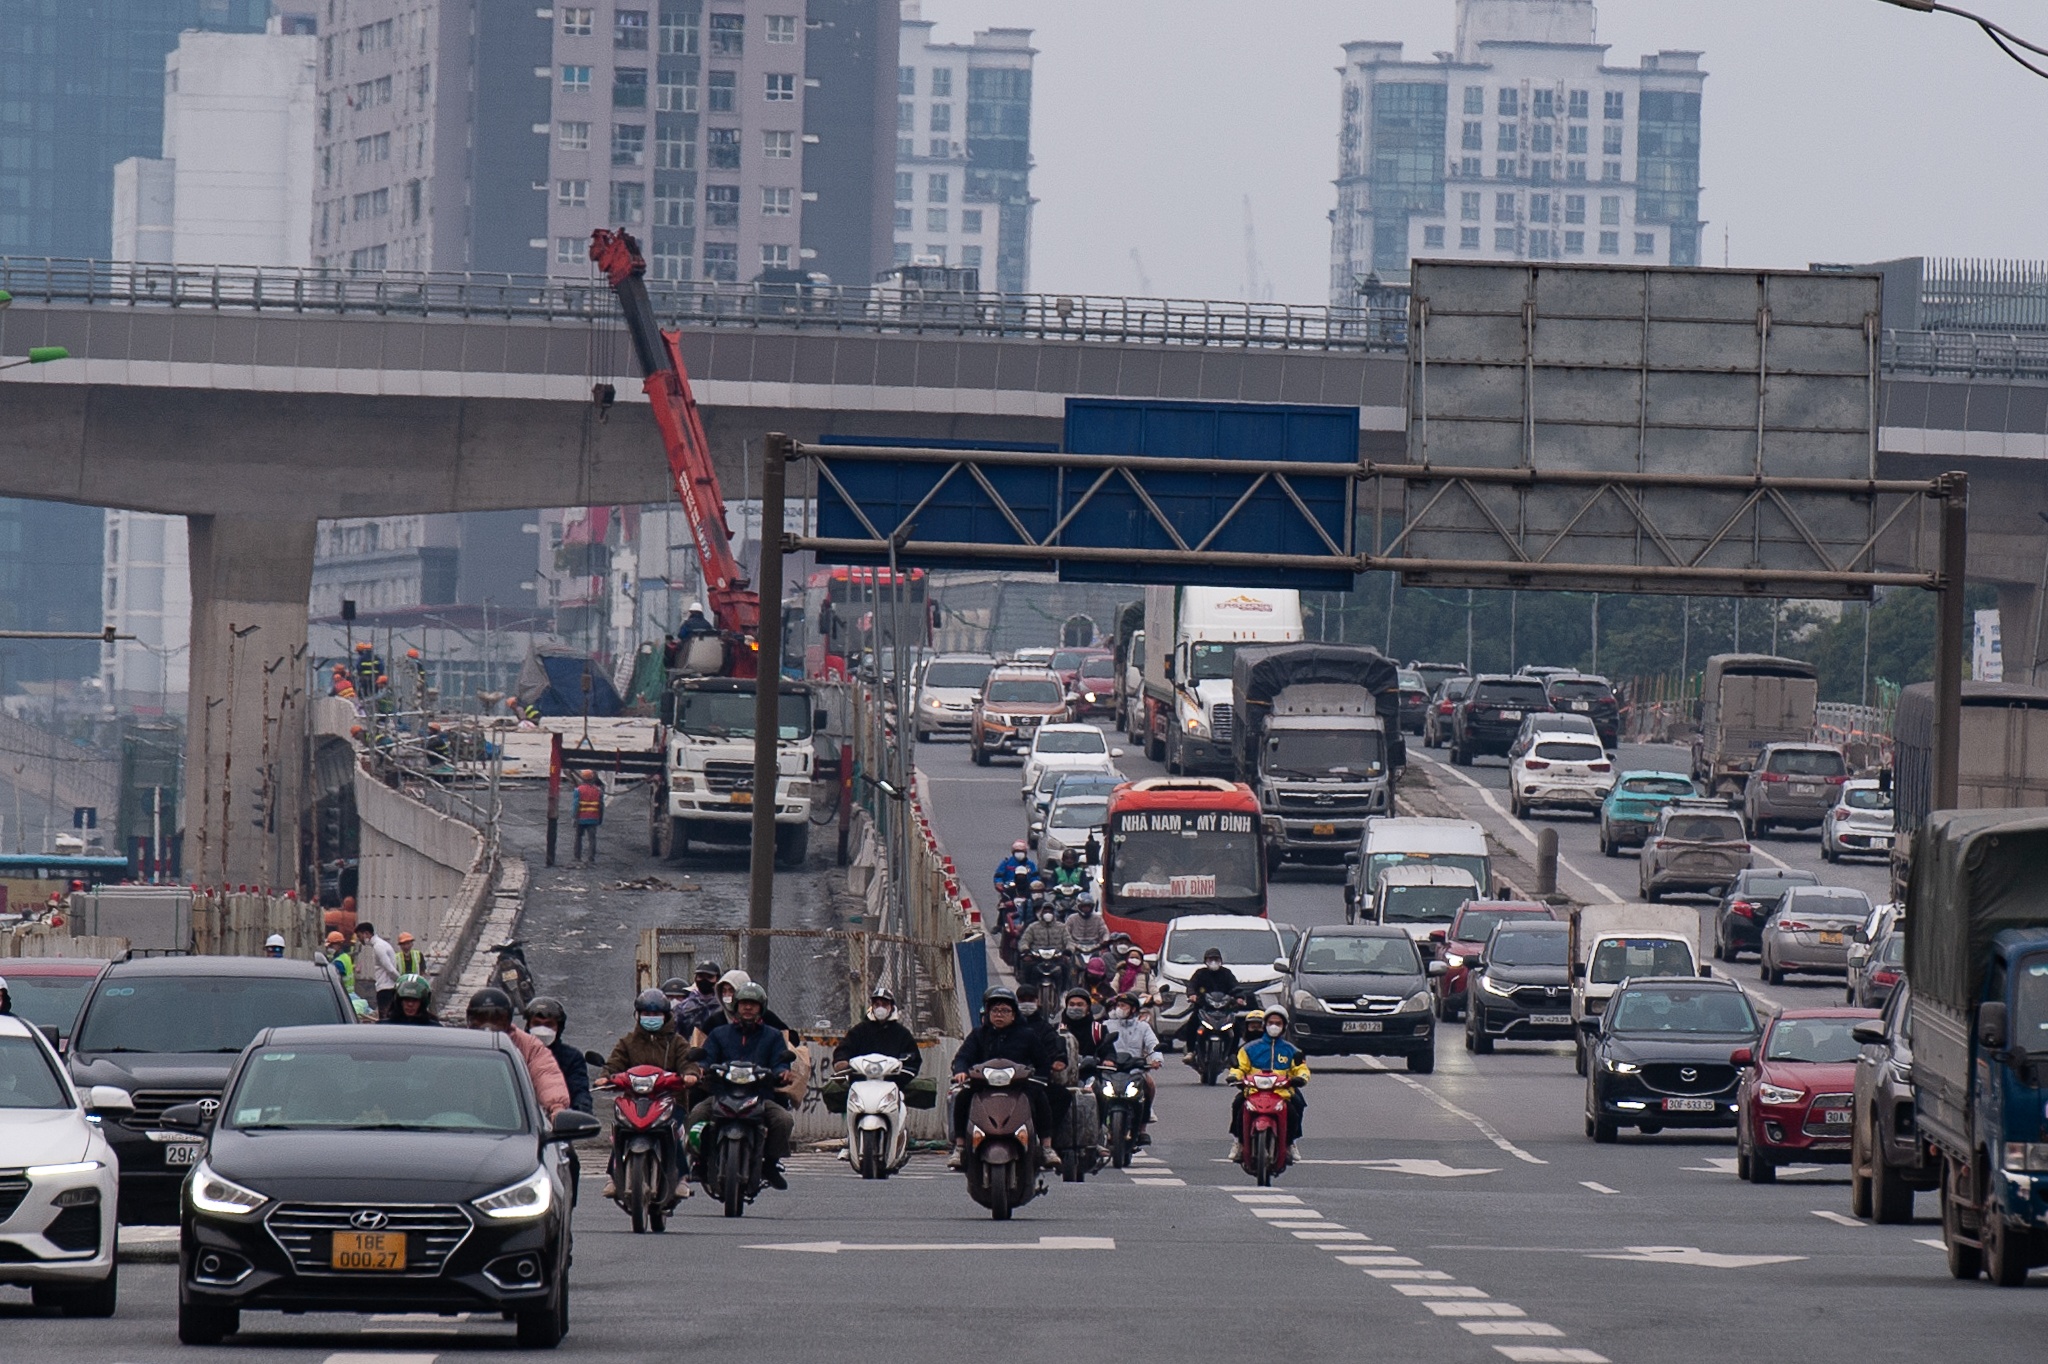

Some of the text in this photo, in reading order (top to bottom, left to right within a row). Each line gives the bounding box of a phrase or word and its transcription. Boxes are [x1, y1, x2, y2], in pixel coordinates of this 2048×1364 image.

[1121, 812, 1148, 832] NHÃ
[1151, 815, 1182, 832] NAM
[1196, 812, 1218, 832] MỸ
[1220, 811, 1252, 833] ĐÌNH
[1171, 877, 1188, 896] MỸ
[1190, 876, 1215, 896] ĐÌNH
[355, 1234, 386, 1251] 18E
[339, 1251, 399, 1268] 000.27
